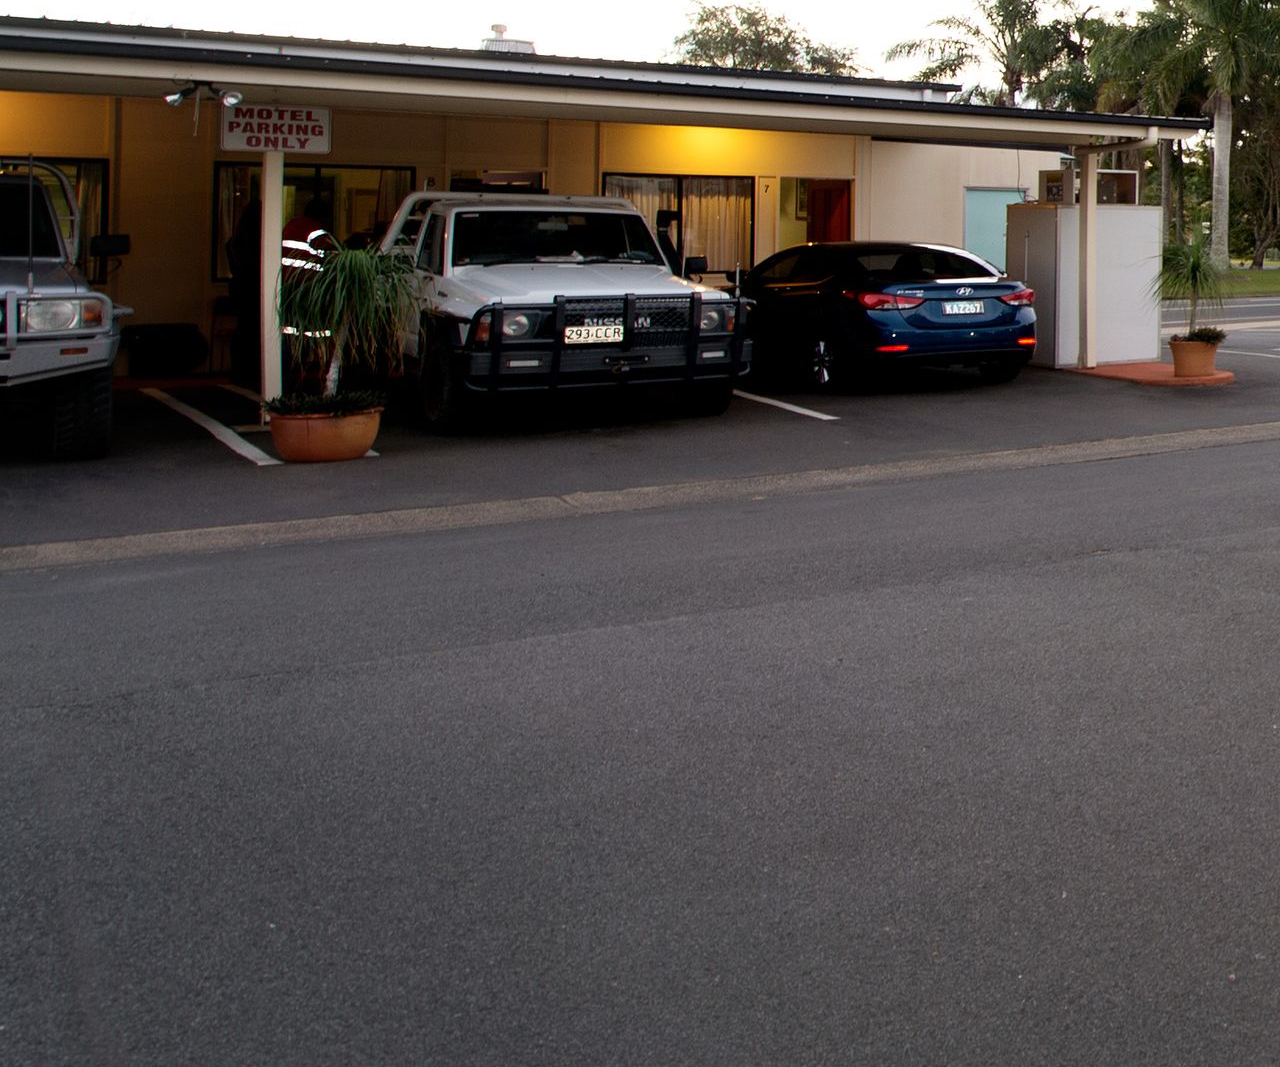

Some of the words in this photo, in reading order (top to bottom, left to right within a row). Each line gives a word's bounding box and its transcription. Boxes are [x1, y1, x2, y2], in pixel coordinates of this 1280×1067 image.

[234, 107, 320, 122] MOTEL
[228, 121, 324, 136] PARKING
[246, 135, 310, 150] ONLY
[764, 184, 770, 194] 7
[583, 317, 651, 328] NISSN
